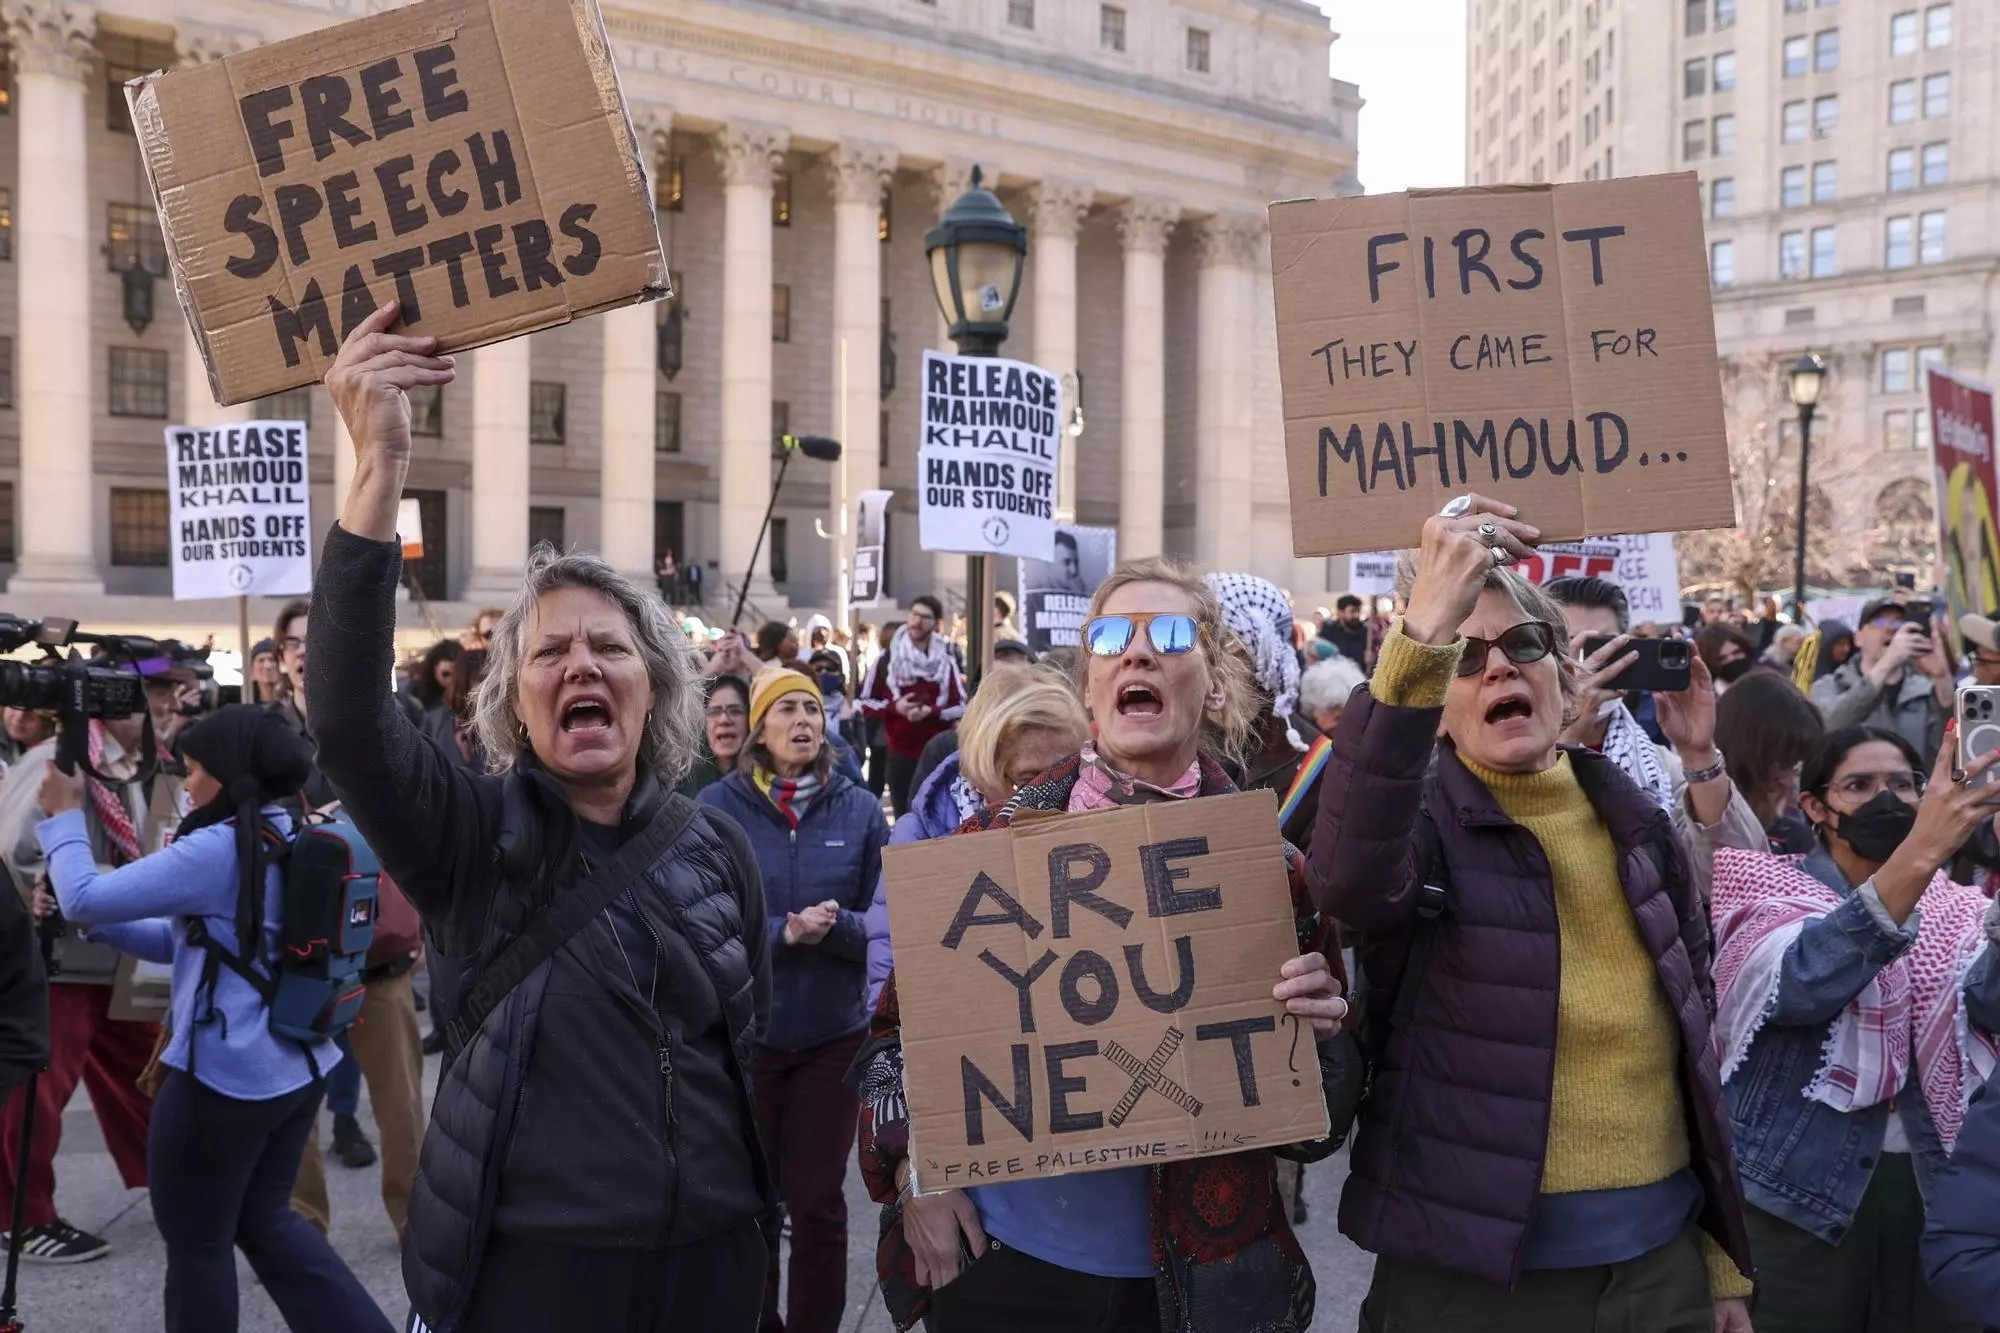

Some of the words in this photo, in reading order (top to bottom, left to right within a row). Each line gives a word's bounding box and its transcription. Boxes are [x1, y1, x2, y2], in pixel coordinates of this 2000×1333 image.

[728, 64, 858, 110] COURT
[240, 44, 469, 178] FREE
[223, 129, 522, 279] SPEECH
[1366, 225, 1625, 303] FIRST
[267, 203, 602, 368] MATTERS
[1311, 338, 1417, 386] THEY
[1449, 334, 1552, 370] CAME
[1590, 327, 1658, 363] FOR
[928, 358, 1056, 410] RELEASE
[927, 396, 1054, 437] MAHMOUD
[175, 428, 302, 462] RELEASE
[926, 425, 1053, 460] KHALIL
[1317, 412, 1688, 497] MAHMOUD...
[179, 461, 303, 488] MAHMOUD
[927, 458, 1015, 490] HANDS
[1022, 467, 1053, 498] OFF
[180, 487, 305, 508] KHALIL
[927, 487, 965, 508] OUR
[971, 489, 1052, 520] STUDENTS
[181, 515, 256, 543] HANDS
[265, 515, 305, 538] OFF
[182, 545, 214, 562] OUR
[221, 540, 306, 559] STUDENTS
[1035, 611, 1083, 629] MAHM
[1044, 594, 1091, 612] RELEAS
[1051, 629, 1082, 647] KHA
[939, 836, 1223, 950] ARE
[977, 935, 1195, 1033] YOU
[961, 1012, 1301, 1146] NEXT?
[944, 1156, 1025, 1182] FREE
[1035, 1142, 1168, 1171] PALESTINE
